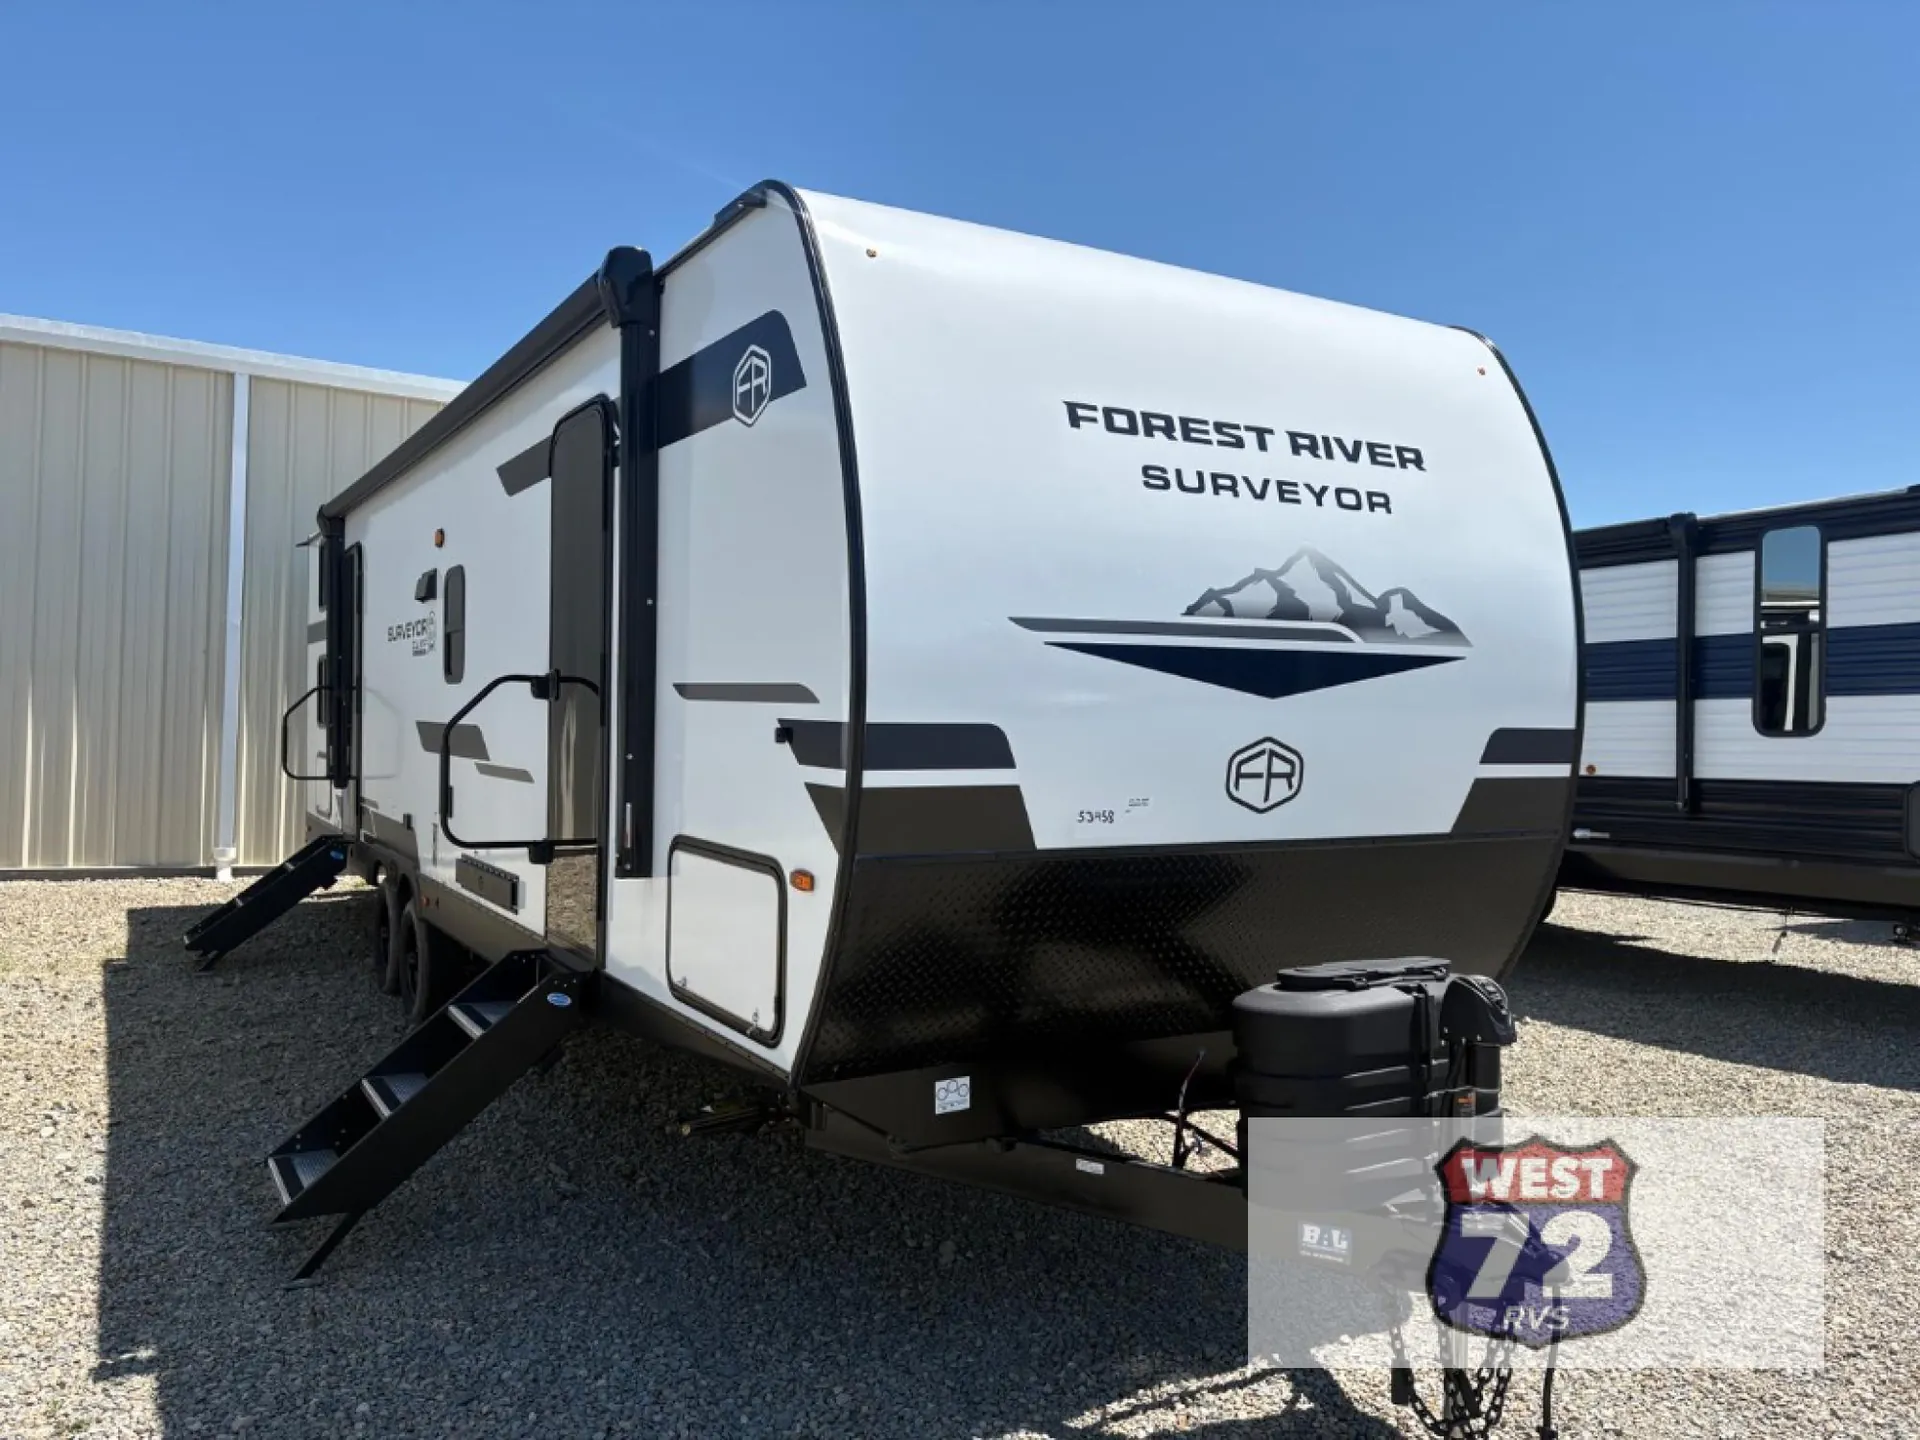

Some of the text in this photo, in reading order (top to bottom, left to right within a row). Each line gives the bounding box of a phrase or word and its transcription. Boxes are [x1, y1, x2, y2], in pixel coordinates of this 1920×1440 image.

[1063, 400, 1427, 471] FOREST RIVER
[1141, 463, 1393, 514] SURVEYOR
